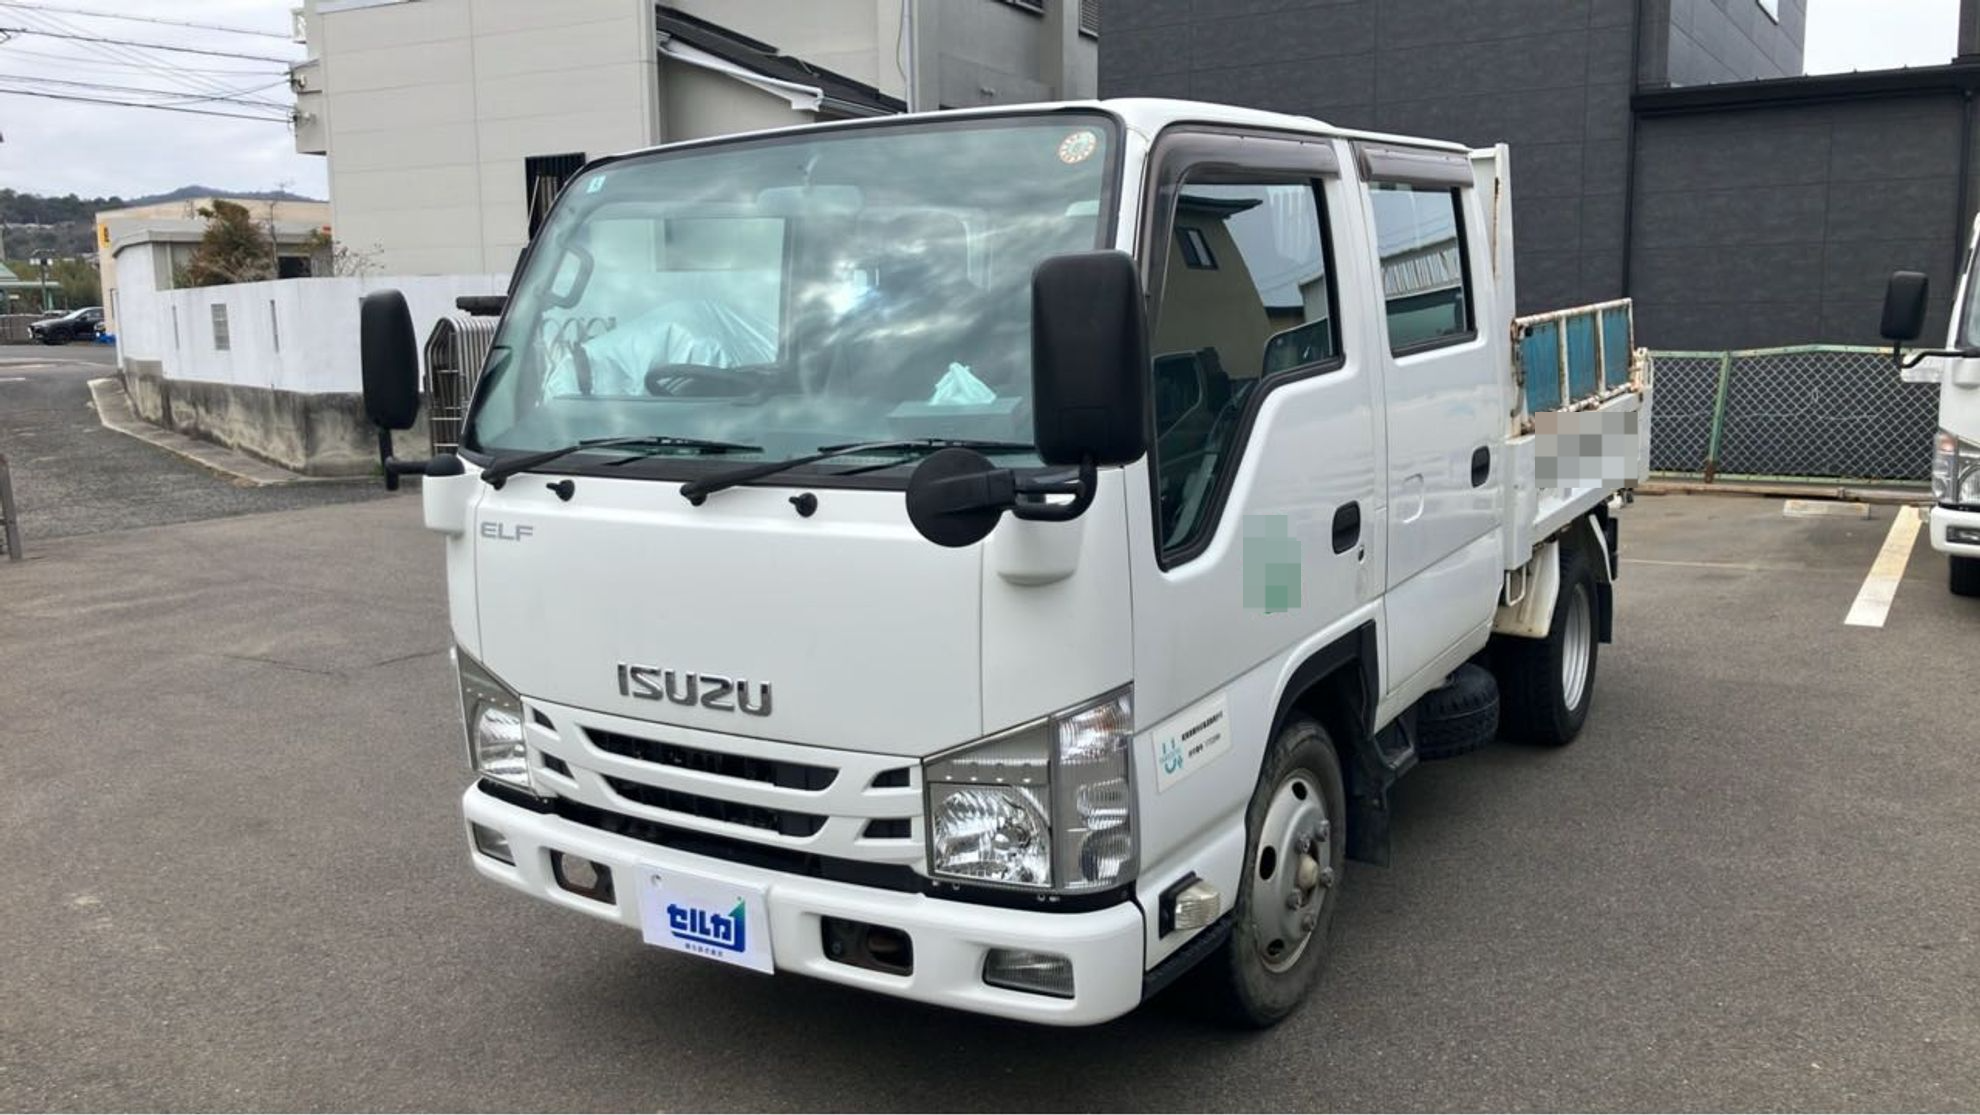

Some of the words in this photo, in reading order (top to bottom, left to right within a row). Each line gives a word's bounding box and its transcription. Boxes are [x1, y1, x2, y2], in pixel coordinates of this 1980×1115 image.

[481, 522, 533, 541] ELF
[617, 660, 772, 717] ISUZU
[667, 903, 732, 942] セルカ
